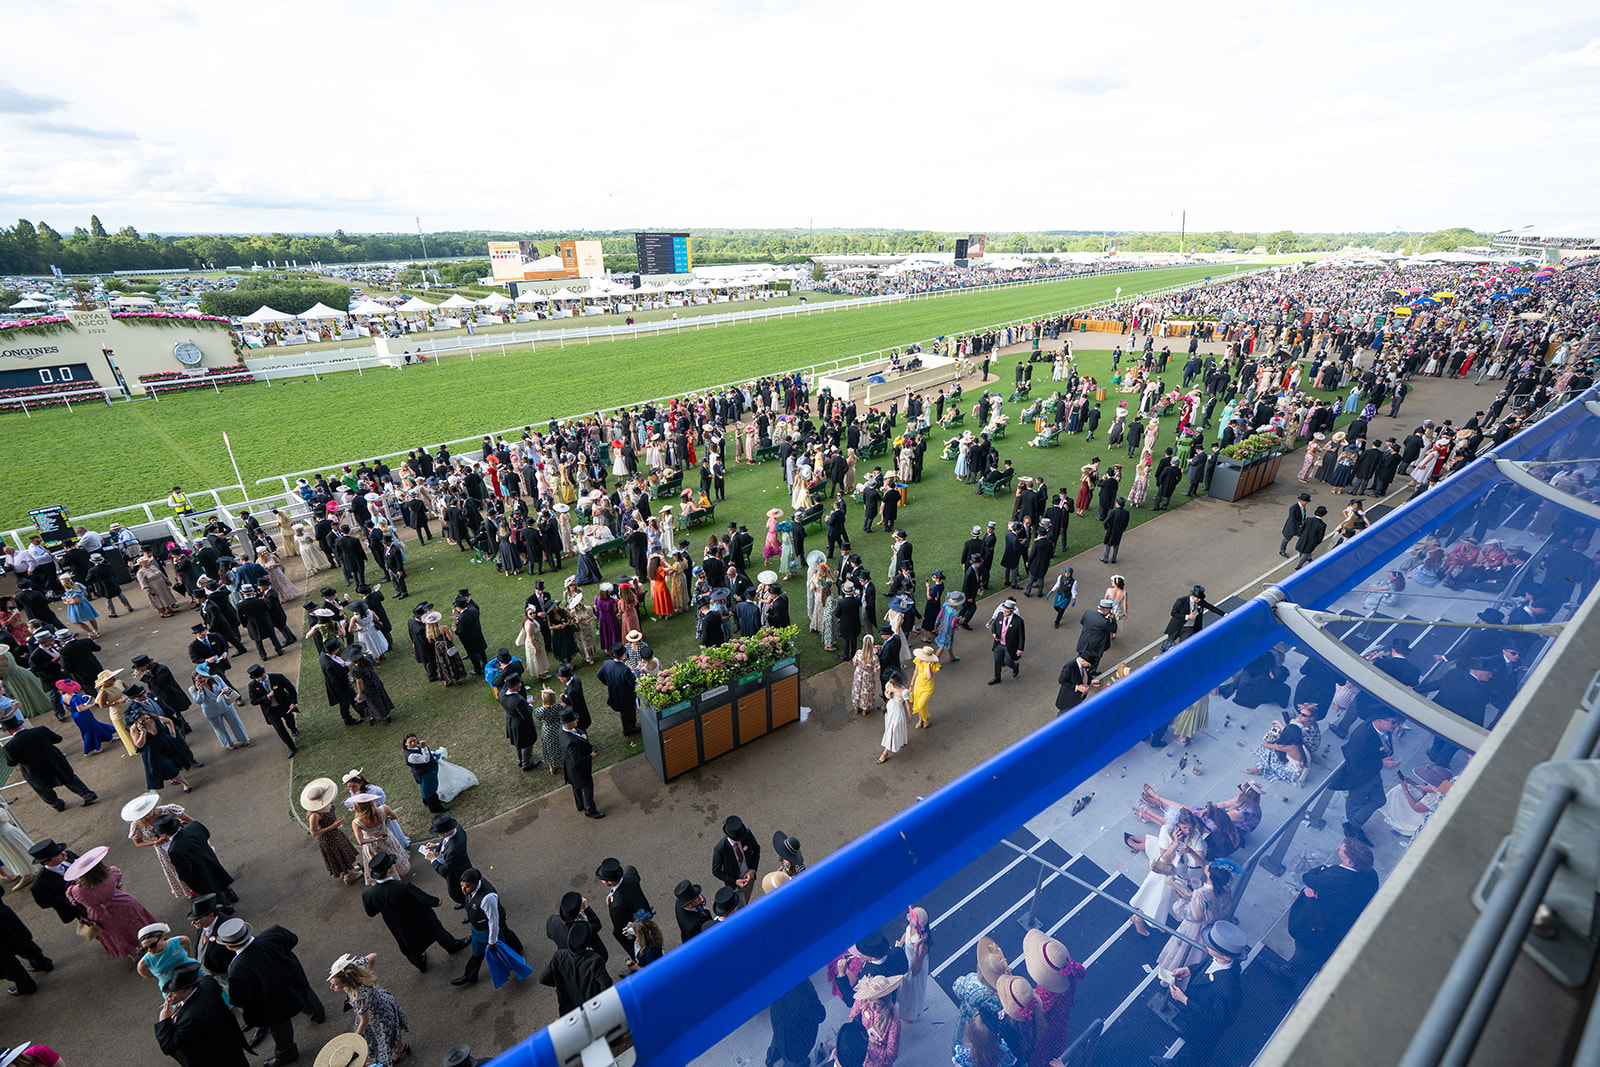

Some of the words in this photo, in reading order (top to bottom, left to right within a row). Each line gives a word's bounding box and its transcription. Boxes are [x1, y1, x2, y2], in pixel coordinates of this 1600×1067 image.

[521, 288, 551, 296] RYAL
[566, 285, 587, 294] SCOT
[78, 319, 109, 327] ASCOT
